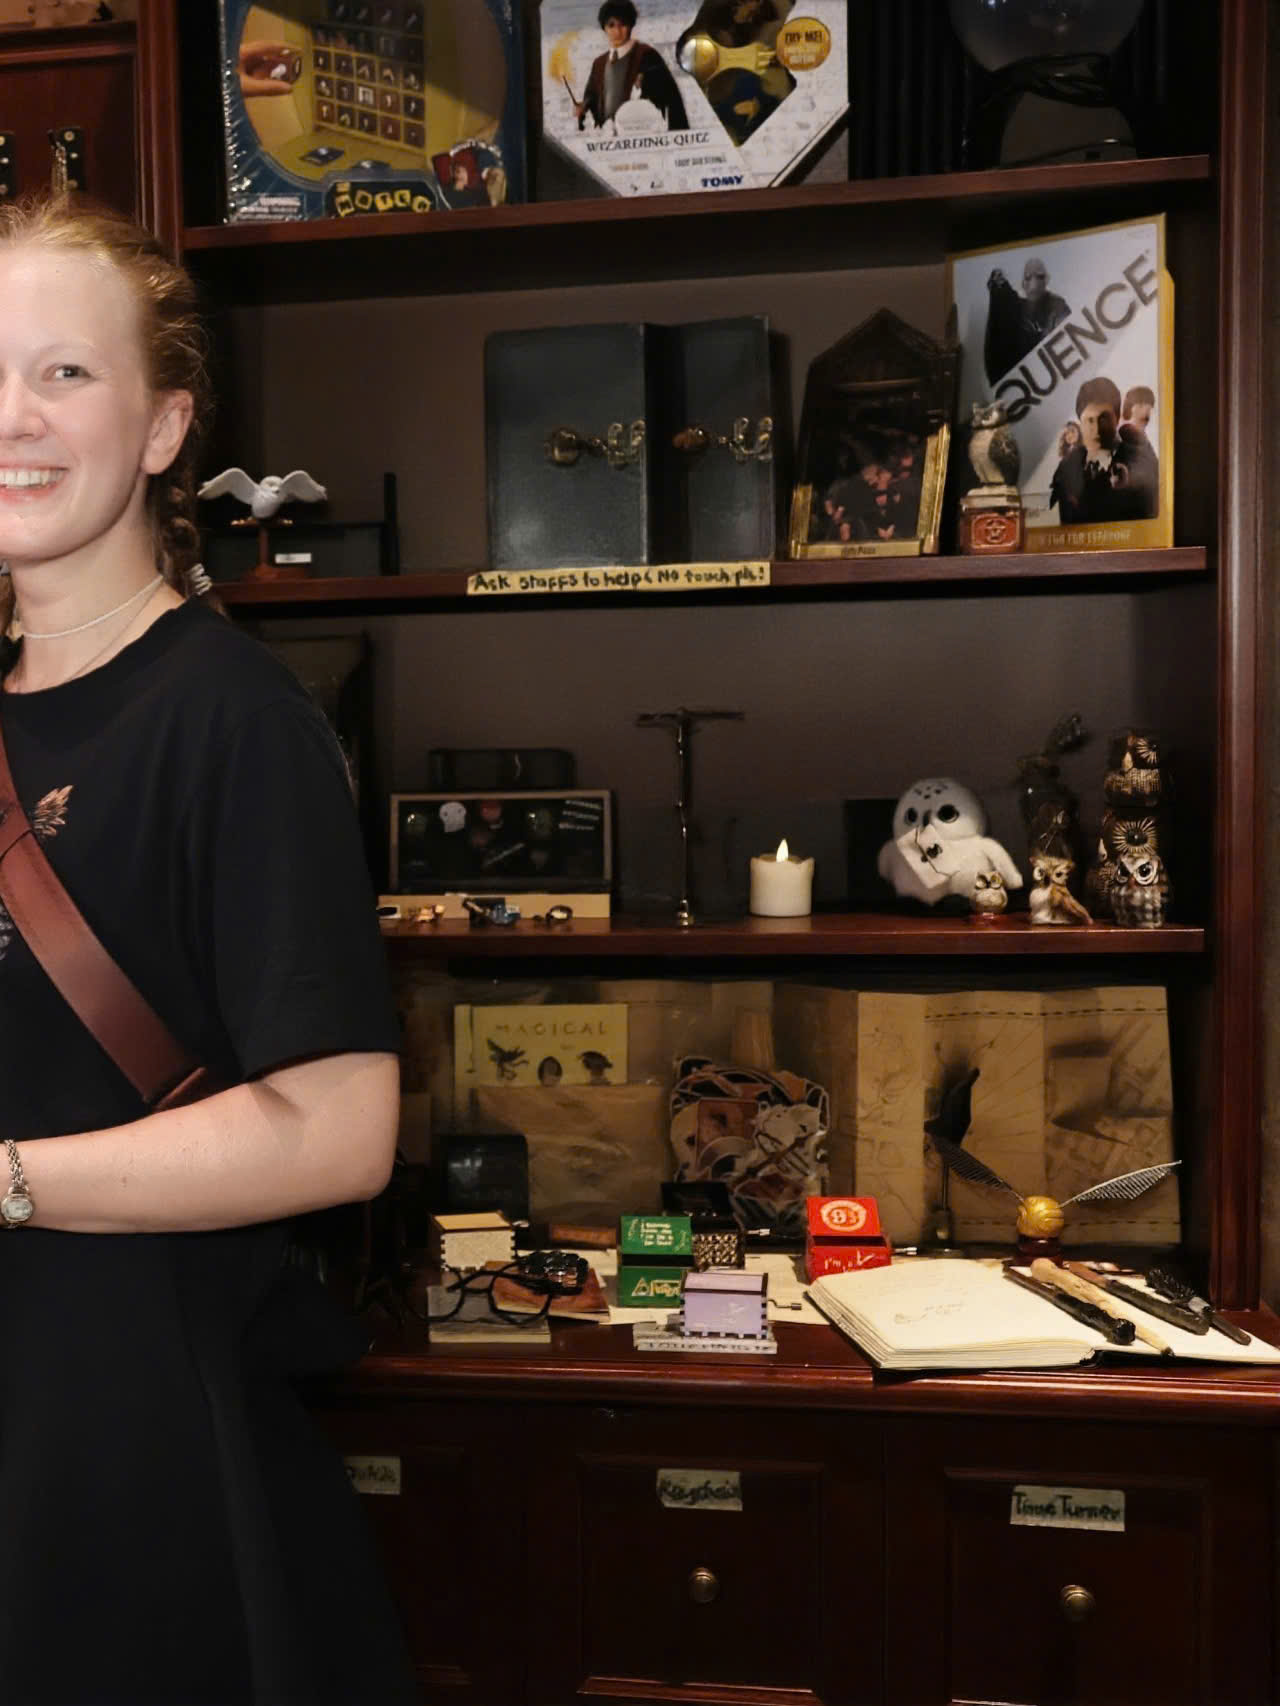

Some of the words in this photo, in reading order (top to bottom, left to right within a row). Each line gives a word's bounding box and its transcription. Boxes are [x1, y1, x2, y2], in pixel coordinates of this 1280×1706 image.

[586, 135, 670, 153] WIZARDING
[673, 132, 710, 147] QUIZ
[701, 175, 744, 188] TOMY
[994, 253, 1158, 424] QUENCE
[473, 573, 512, 591] Ask
[583, 570, 600, 588] to
[683, 566, 730, 583] touch
[495, 1020, 609, 1036] MAGICAL
